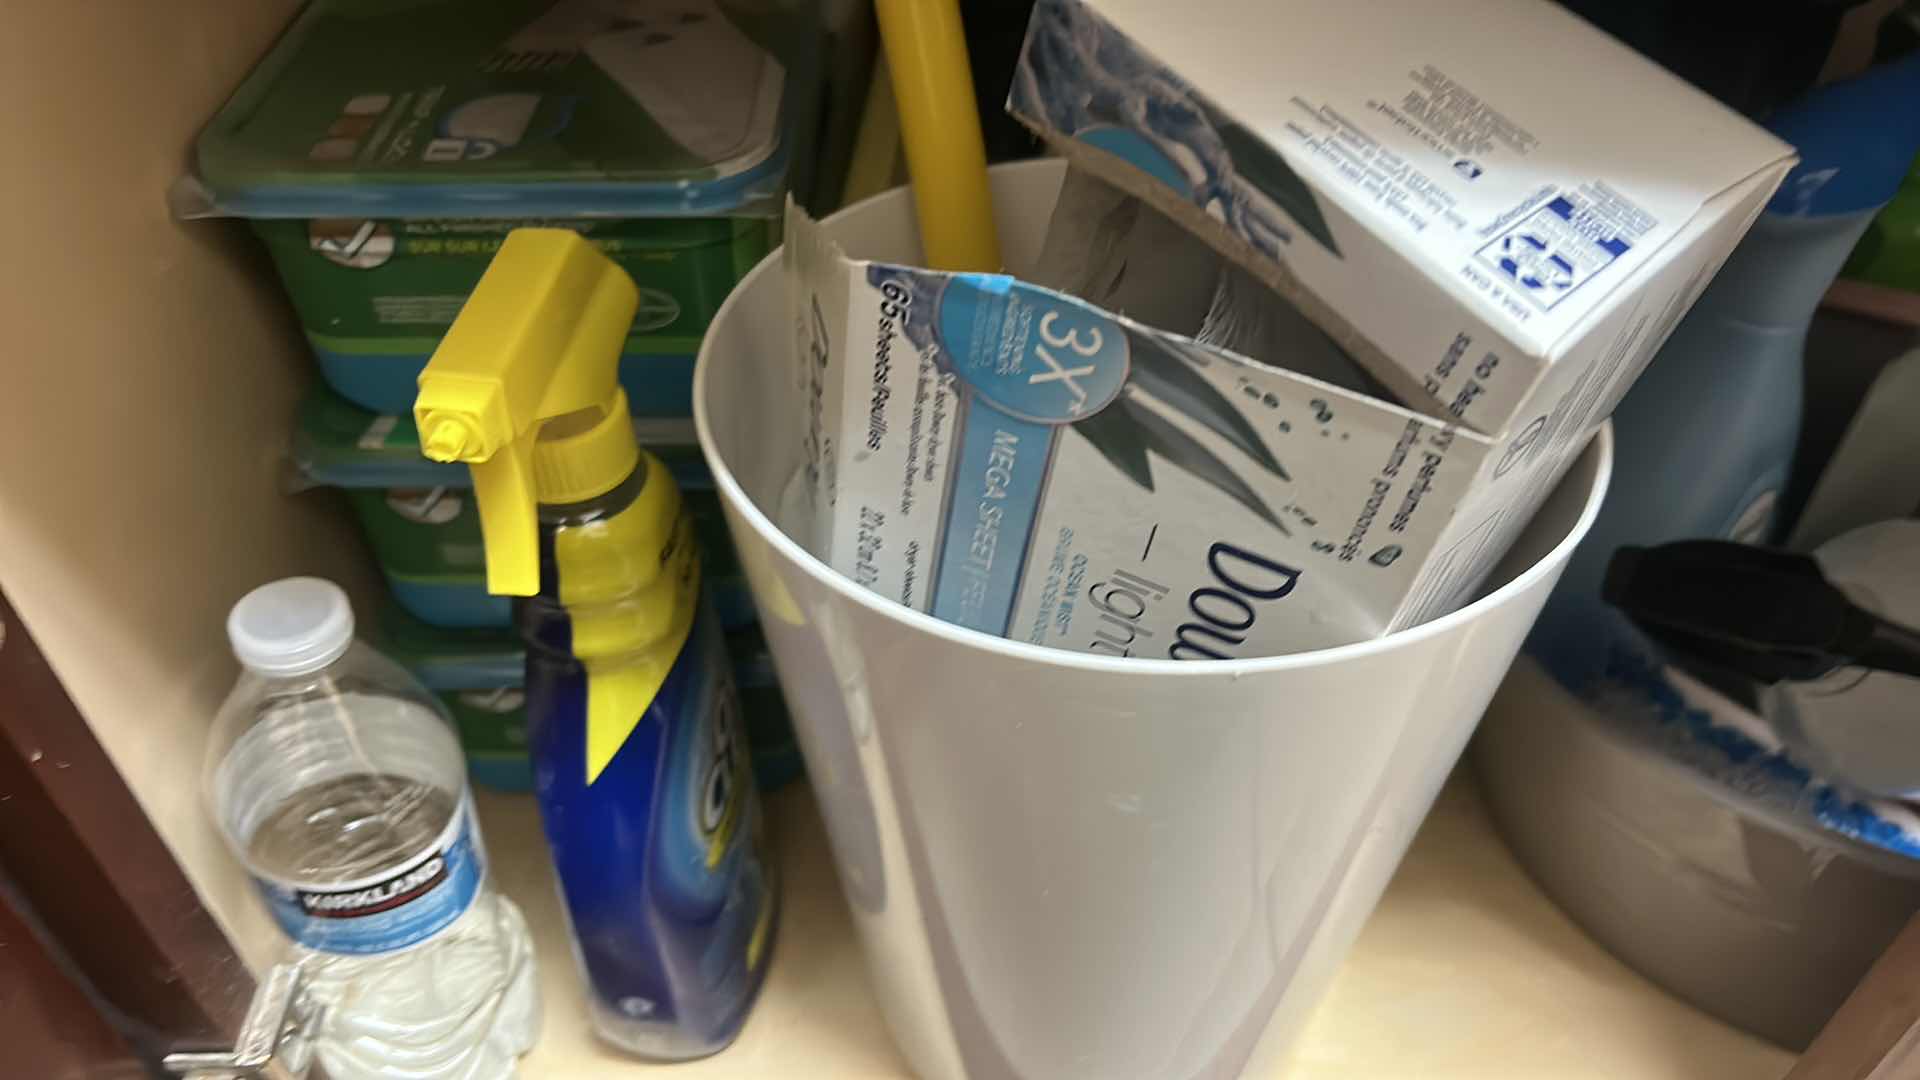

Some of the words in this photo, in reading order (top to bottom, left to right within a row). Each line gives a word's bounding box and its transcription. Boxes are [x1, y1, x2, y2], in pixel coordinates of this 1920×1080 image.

[880, 279, 911, 327] 65
[983, 429, 1020, 501] MEGA
[1390, 449, 1442, 533] perfumes
[1087, 568, 1170, 658] light
